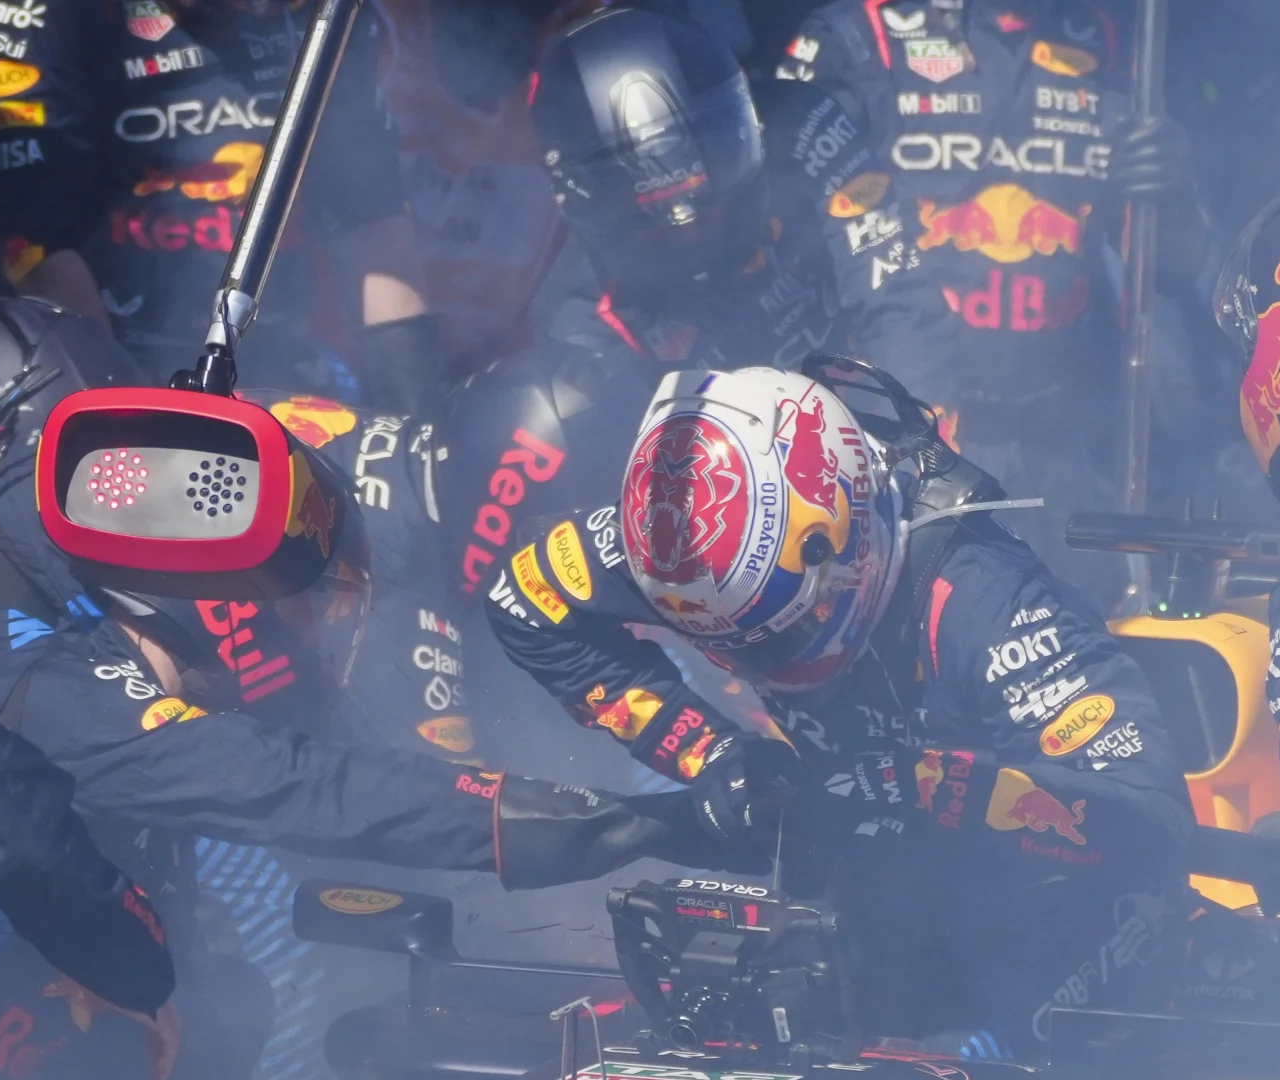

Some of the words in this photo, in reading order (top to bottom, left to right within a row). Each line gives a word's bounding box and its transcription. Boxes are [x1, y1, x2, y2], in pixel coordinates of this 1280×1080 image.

[124, 53, 184, 79] Mobil
[898, 93, 957, 115] Mobil
[1036, 86, 1099, 115] BYBIT
[891, 132, 1112, 181] ORACLE
[760, 481, 777, 507] 0.0
[594, 526, 626, 569] Sui
[744, 507, 779, 573] Player
[555, 535, 587, 591] RAUCH
[517, 550, 564, 613] PIRELLI
[488, 568, 540, 628] VIS
[1056, 701, 1108, 744] RAUCH
[1086, 722, 1139, 758] ARCTIC
[457, 774, 498, 800] Red
[676, 897, 728, 910] ORACLE
[677, 879, 769, 898] ORACLE
[744, 904, 759, 927] 1
